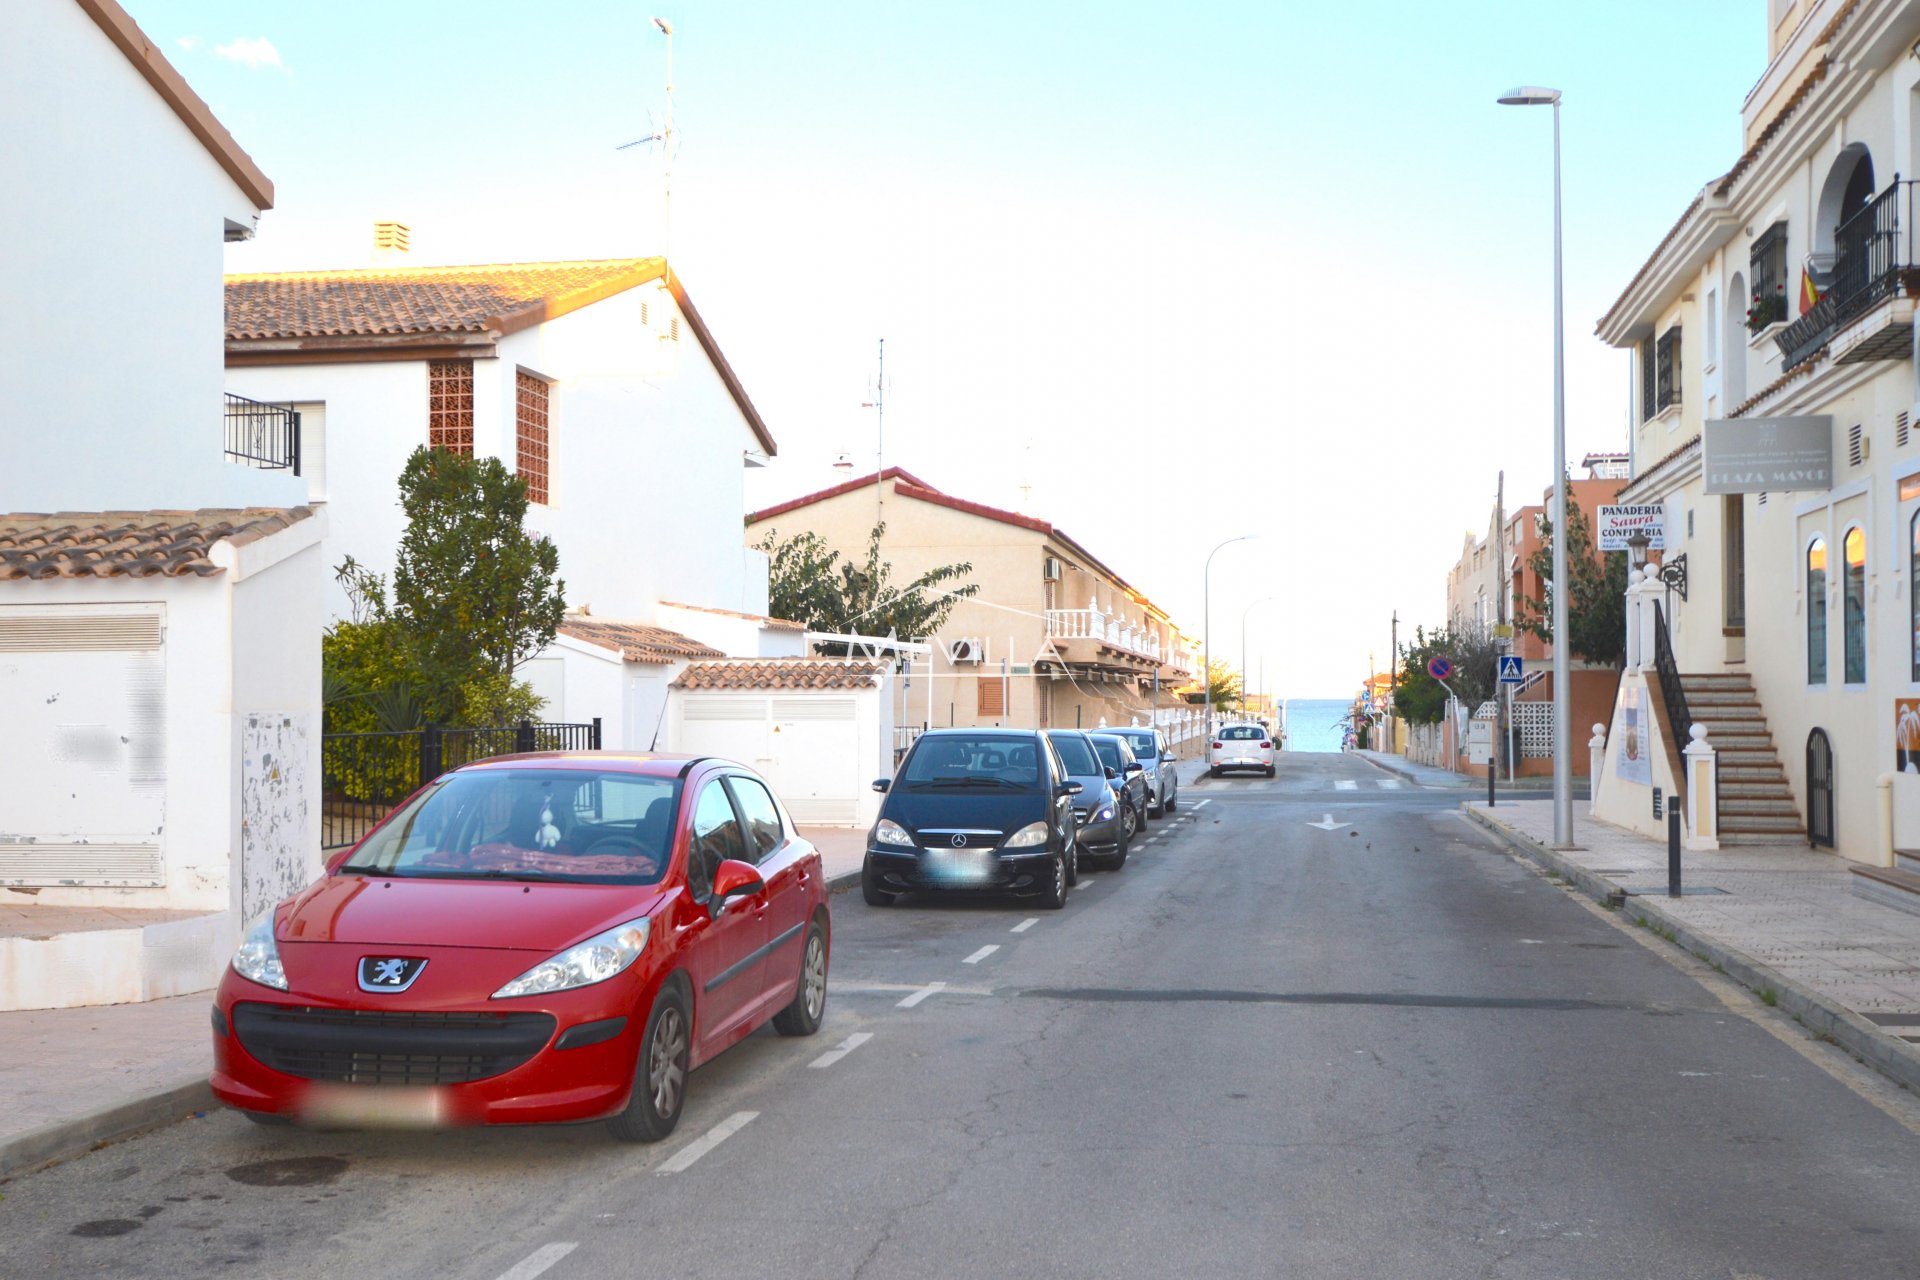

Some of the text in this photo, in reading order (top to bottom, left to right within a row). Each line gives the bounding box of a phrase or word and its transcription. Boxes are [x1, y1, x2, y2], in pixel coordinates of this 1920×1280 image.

[1711, 469, 1829, 484] PLAZA MAYOR
[1602, 505, 1663, 516] PANADERIA
[1610, 515, 1654, 528] Saura
